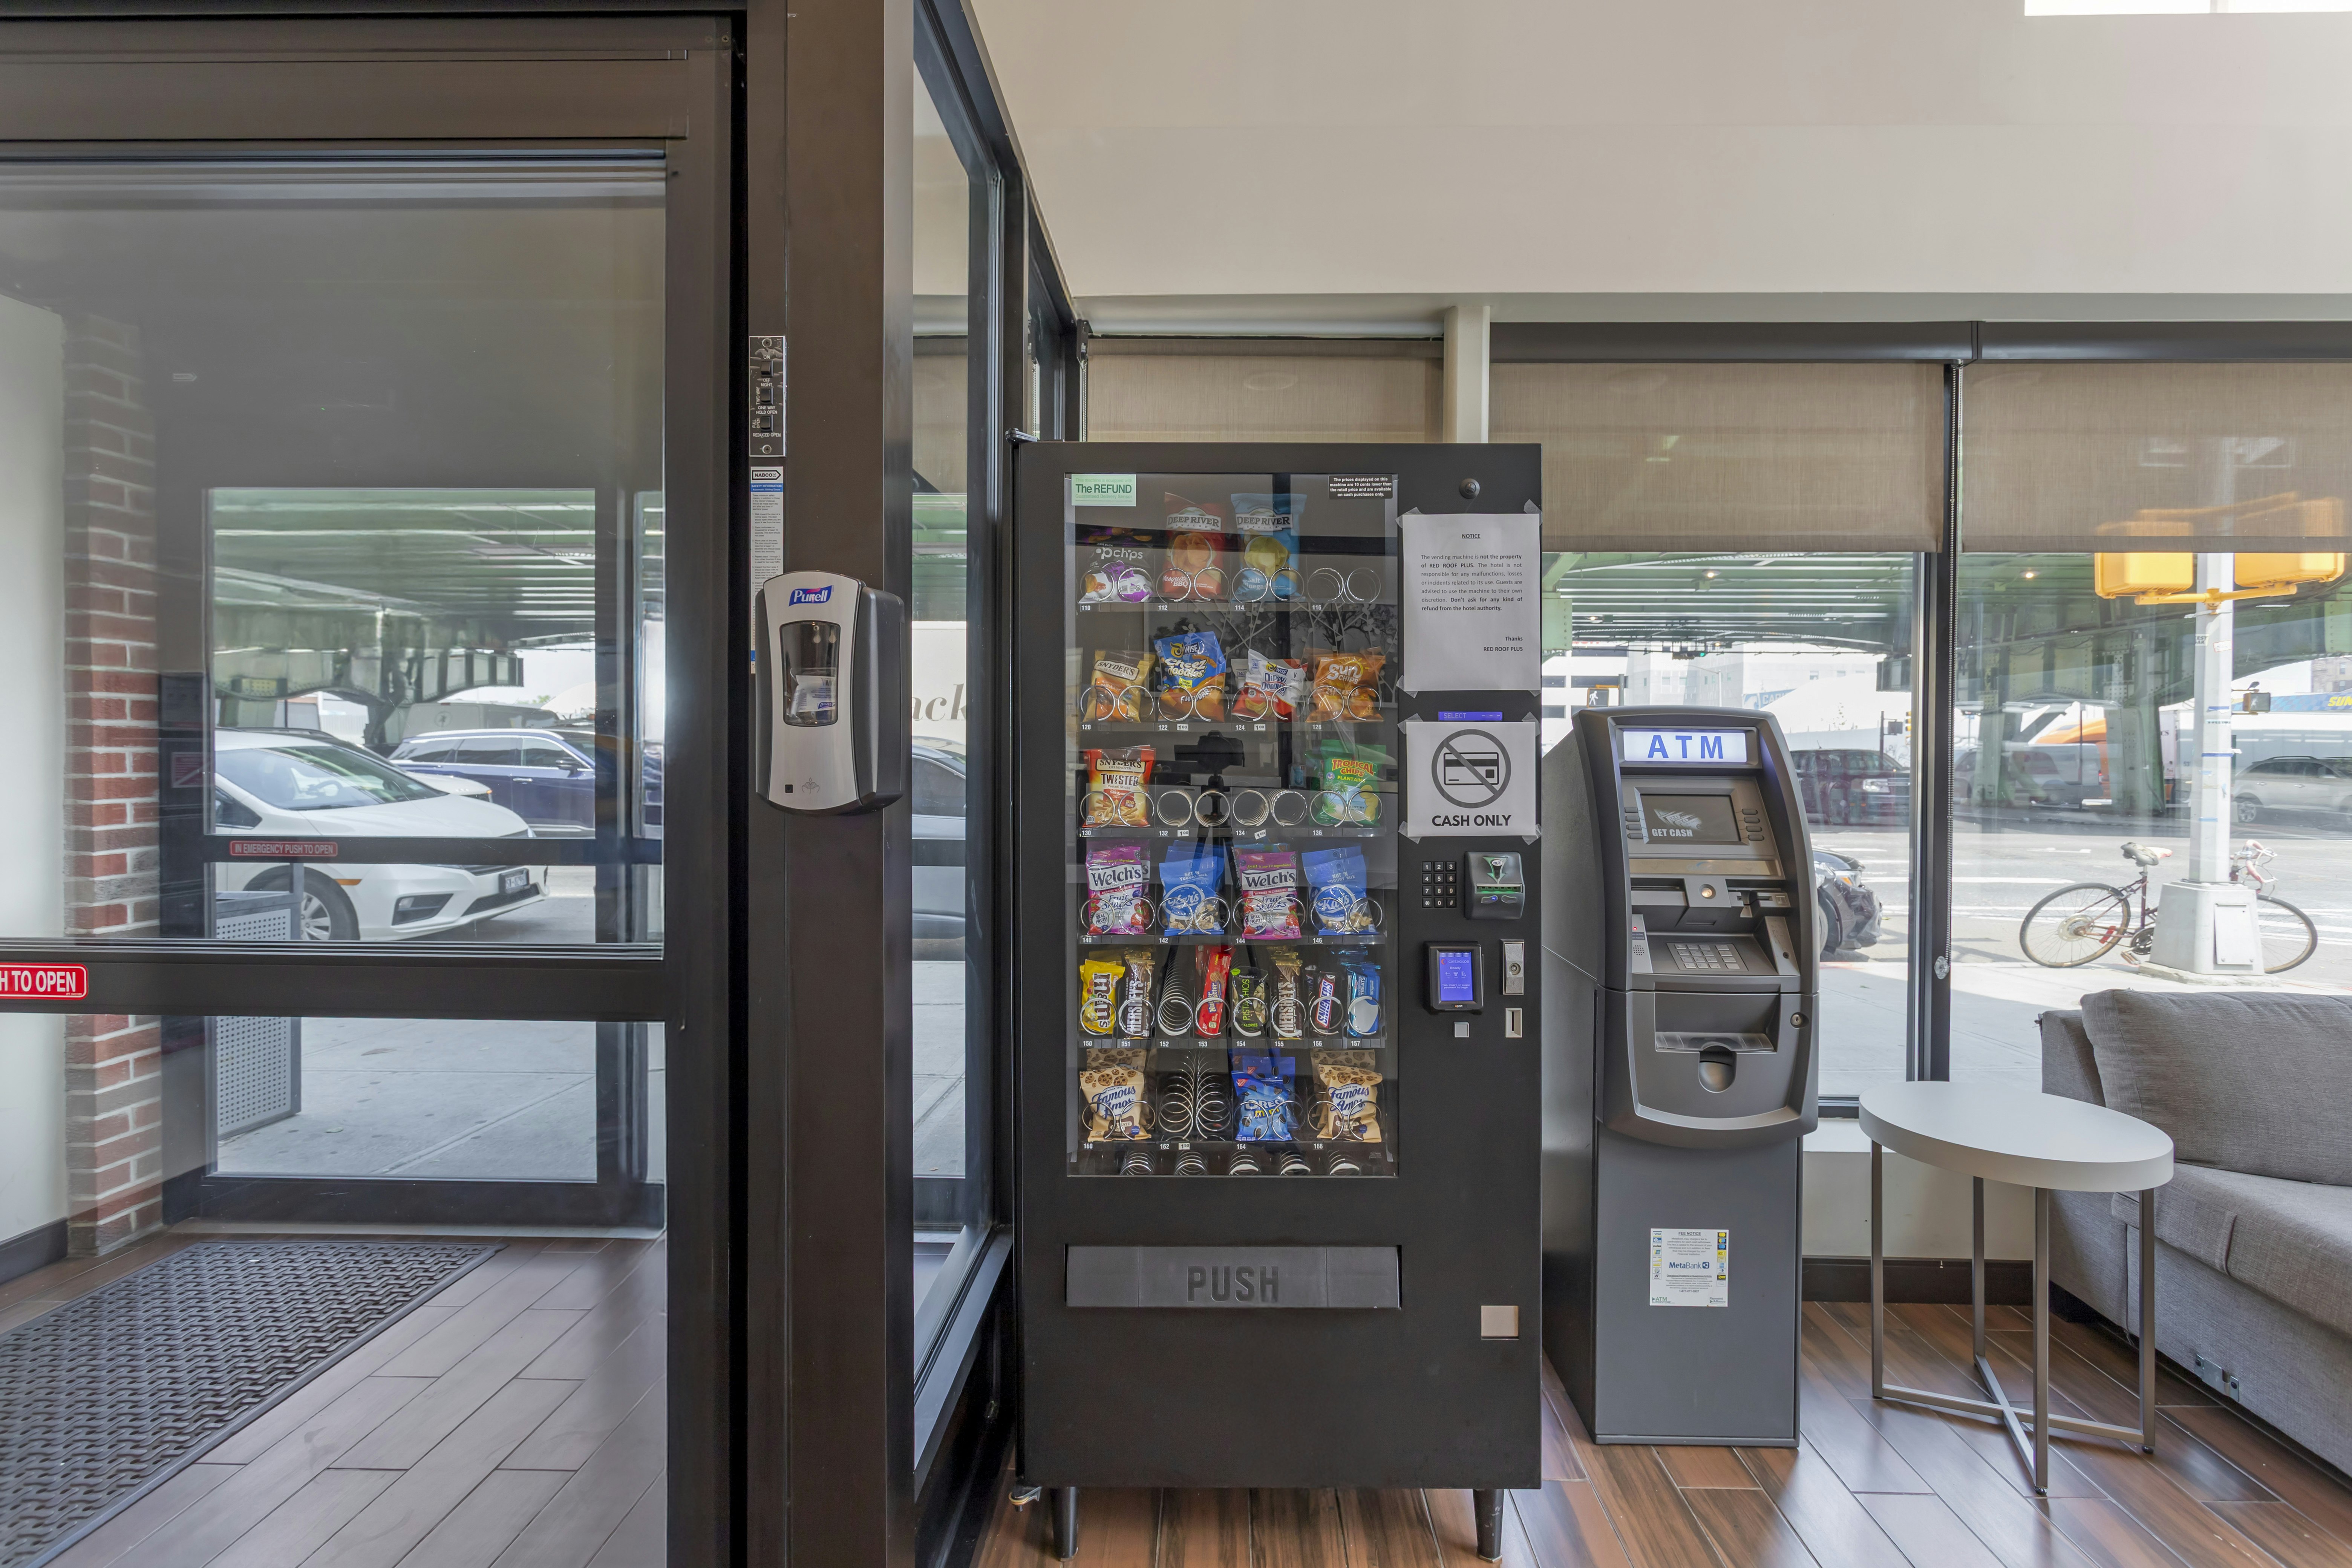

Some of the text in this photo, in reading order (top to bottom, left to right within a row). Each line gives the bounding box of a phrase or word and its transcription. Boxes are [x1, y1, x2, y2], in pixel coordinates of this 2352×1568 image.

[1076, 484, 1132, 493] The REFUND
[1168, 517, 1219, 528] DEEP RIVER
[1237, 516, 1290, 525] DEEP RIVER
[794, 590, 828, 602] Purell
[1184, 644, 1198, 654] WISE
[1098, 662, 1135, 676] SNYDER'S
[1165, 658, 1207, 670] Cheez
[1338, 675, 1358, 684] CHIPS
[1647, 735, 1723, 759] ATM
[1332, 759, 1374, 776] TROPICAL
[1340, 767, 1365, 777] CHIPS
[1432, 815, 1511, 826] CASH ONLY
[1652, 828, 1693, 838] GET CASH
[235, 844, 333, 854] IN EMERGENCY PUSH TO OPEN
[1090, 867, 1141, 887] Welch's
[1244, 871, 1295, 887] Welch's
[12, 970, 32, 992] TO
[35, 970, 76, 992] OPEN
[1328, 1087, 1369, 1099] Famous
[1092, 1086, 1136, 1113] Famous
[1187, 1266, 1279, 1302] PUSH
